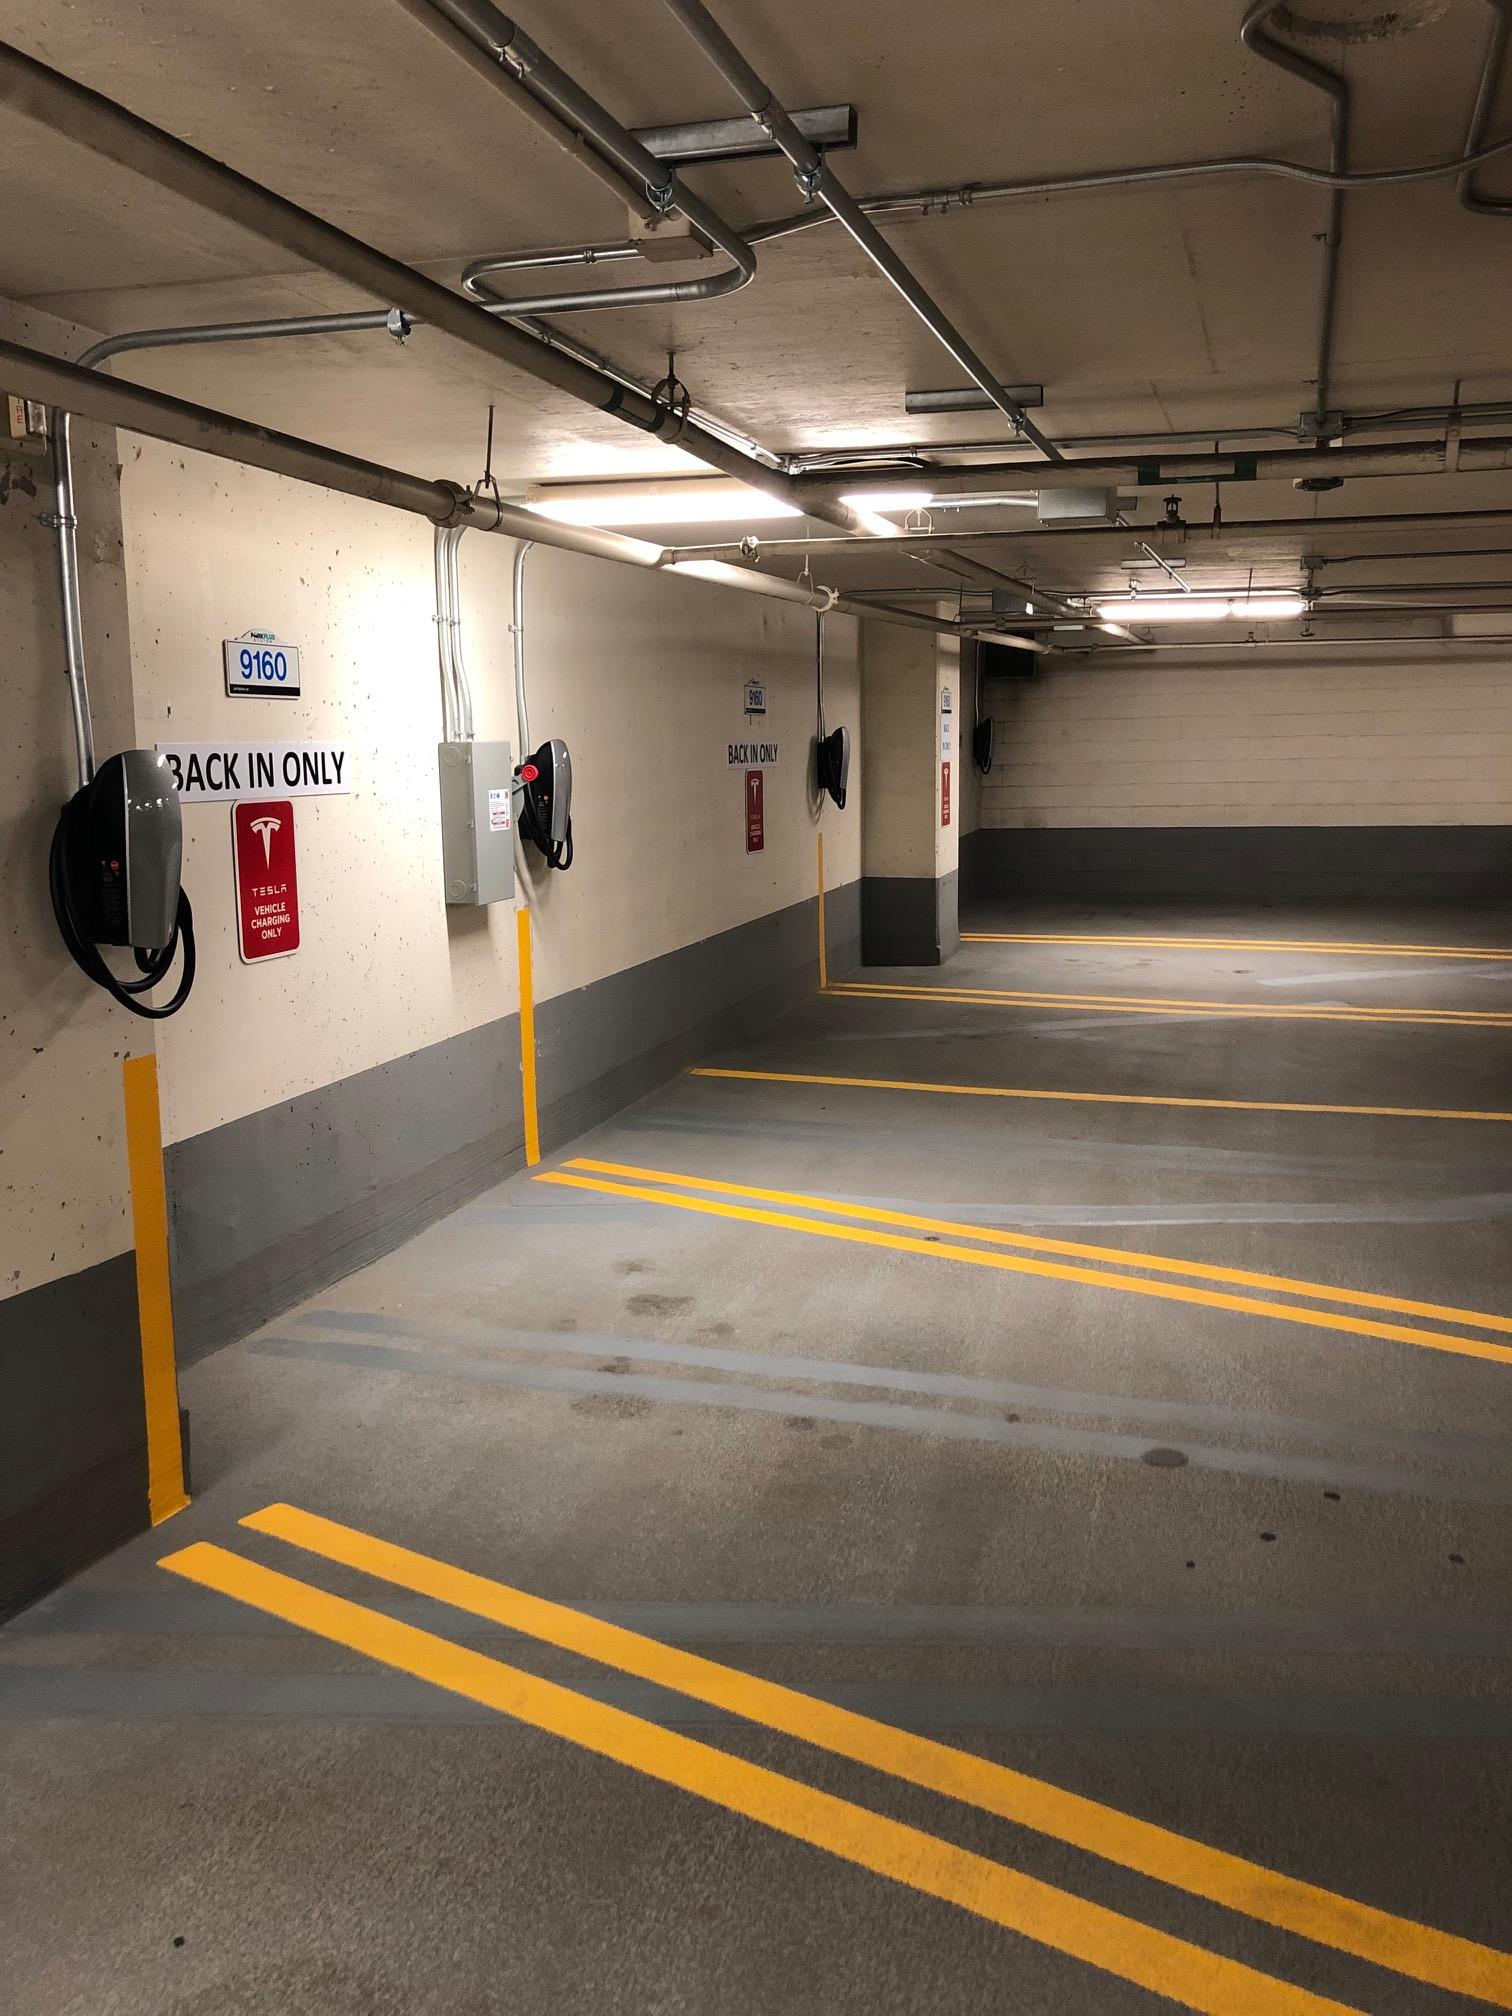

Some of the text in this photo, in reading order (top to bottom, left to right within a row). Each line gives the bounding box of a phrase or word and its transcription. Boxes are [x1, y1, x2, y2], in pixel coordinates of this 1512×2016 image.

[240, 649, 287, 681] 9160
[728, 743, 778, 764] BACK IN ONLY
[166, 751, 345, 792] BACK IN ONLY
[251, 884, 287, 897] TESLA
[254, 902, 286, 916] VEHICLE
[251, 914, 291, 930] CHARGING
[261, 927, 283, 940] ONLY
